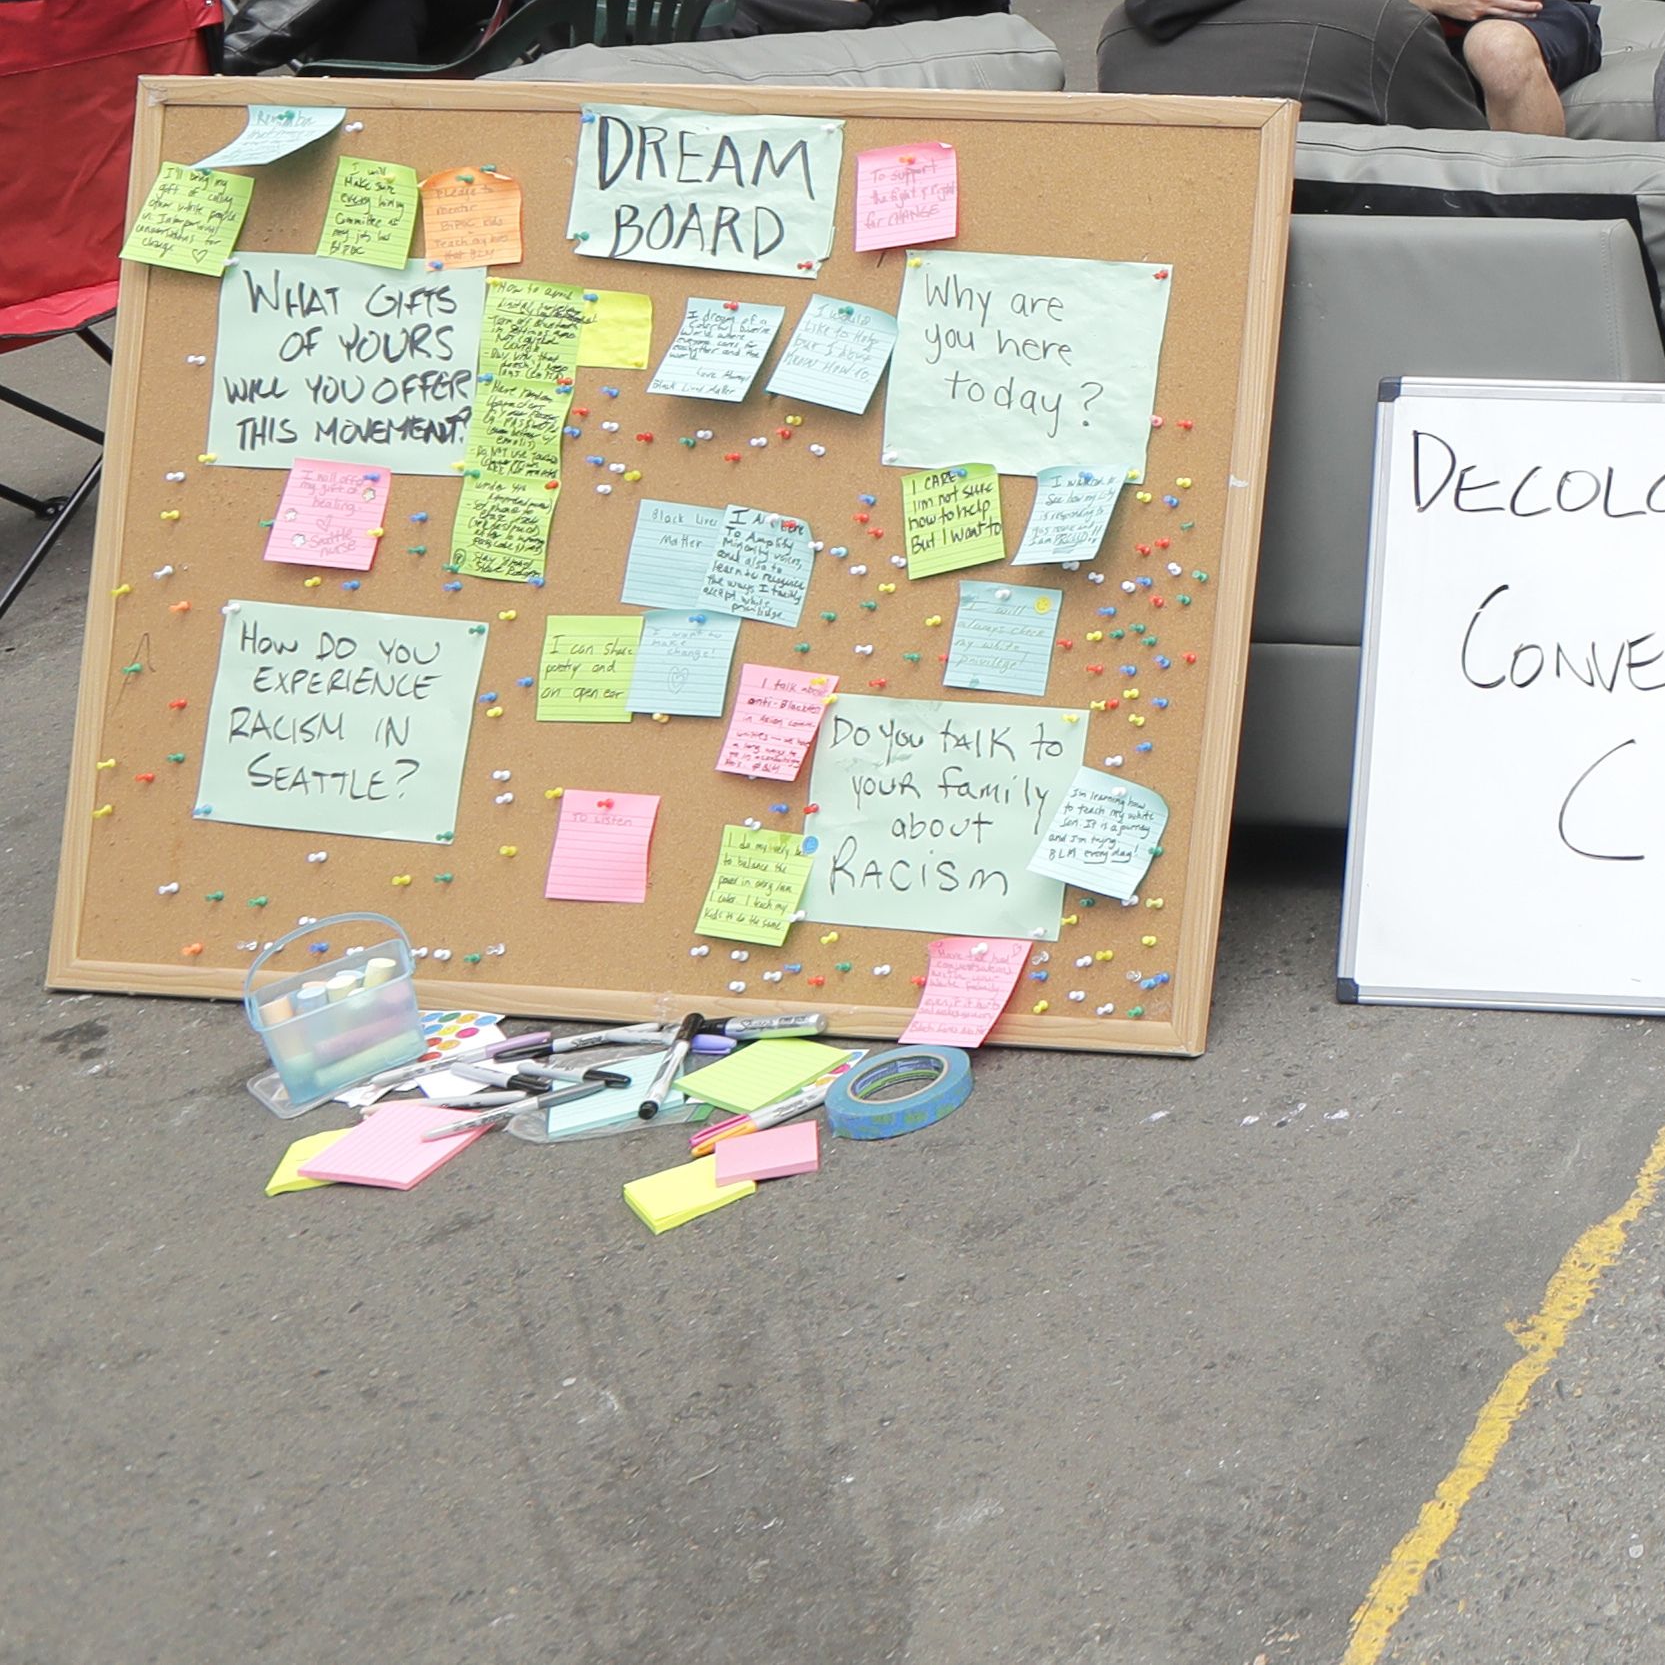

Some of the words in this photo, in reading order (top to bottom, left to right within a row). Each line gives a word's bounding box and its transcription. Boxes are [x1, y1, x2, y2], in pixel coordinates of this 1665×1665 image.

[599, 115, 815, 200] DREAM
[609, 203, 784, 260] BOARD
[243, 270, 340, 318] WHAT
[365, 284, 457, 319] GIFTS
[926, 273, 991, 327] Why
[1010, 292, 1064, 321] are
[279, 327, 330, 364] OF
[338, 321, 454, 363] YOURS
[925, 324, 976, 364] you
[997, 329, 1072, 366] here
[223, 374, 288, 406] WILL
[305, 377, 364, 409] YOU
[372, 369, 474, 408] OFFER
[236, 417, 298, 446] THIS
[924, 471, 957, 491] CARE
[938, 489, 958, 507] not
[908, 514, 937, 531] how
[939, 507, 955, 525] to
[957, 499, 991, 520] help
[911, 534, 935, 555] But
[316, 632, 357, 662] DO
[378, 638, 441, 665] YOU
[592, 660, 616, 673] and
[253, 666, 443, 700] EXPERIENCE
[228, 706, 345, 744] RACISM
[375, 716, 410, 748] IN
[829, 715, 870, 749] Do
[1030, 722, 1063, 760] to
[248, 753, 420, 802] SEATTLE?
[938, 766, 1049, 835] family
[891, 813, 993, 844] about
